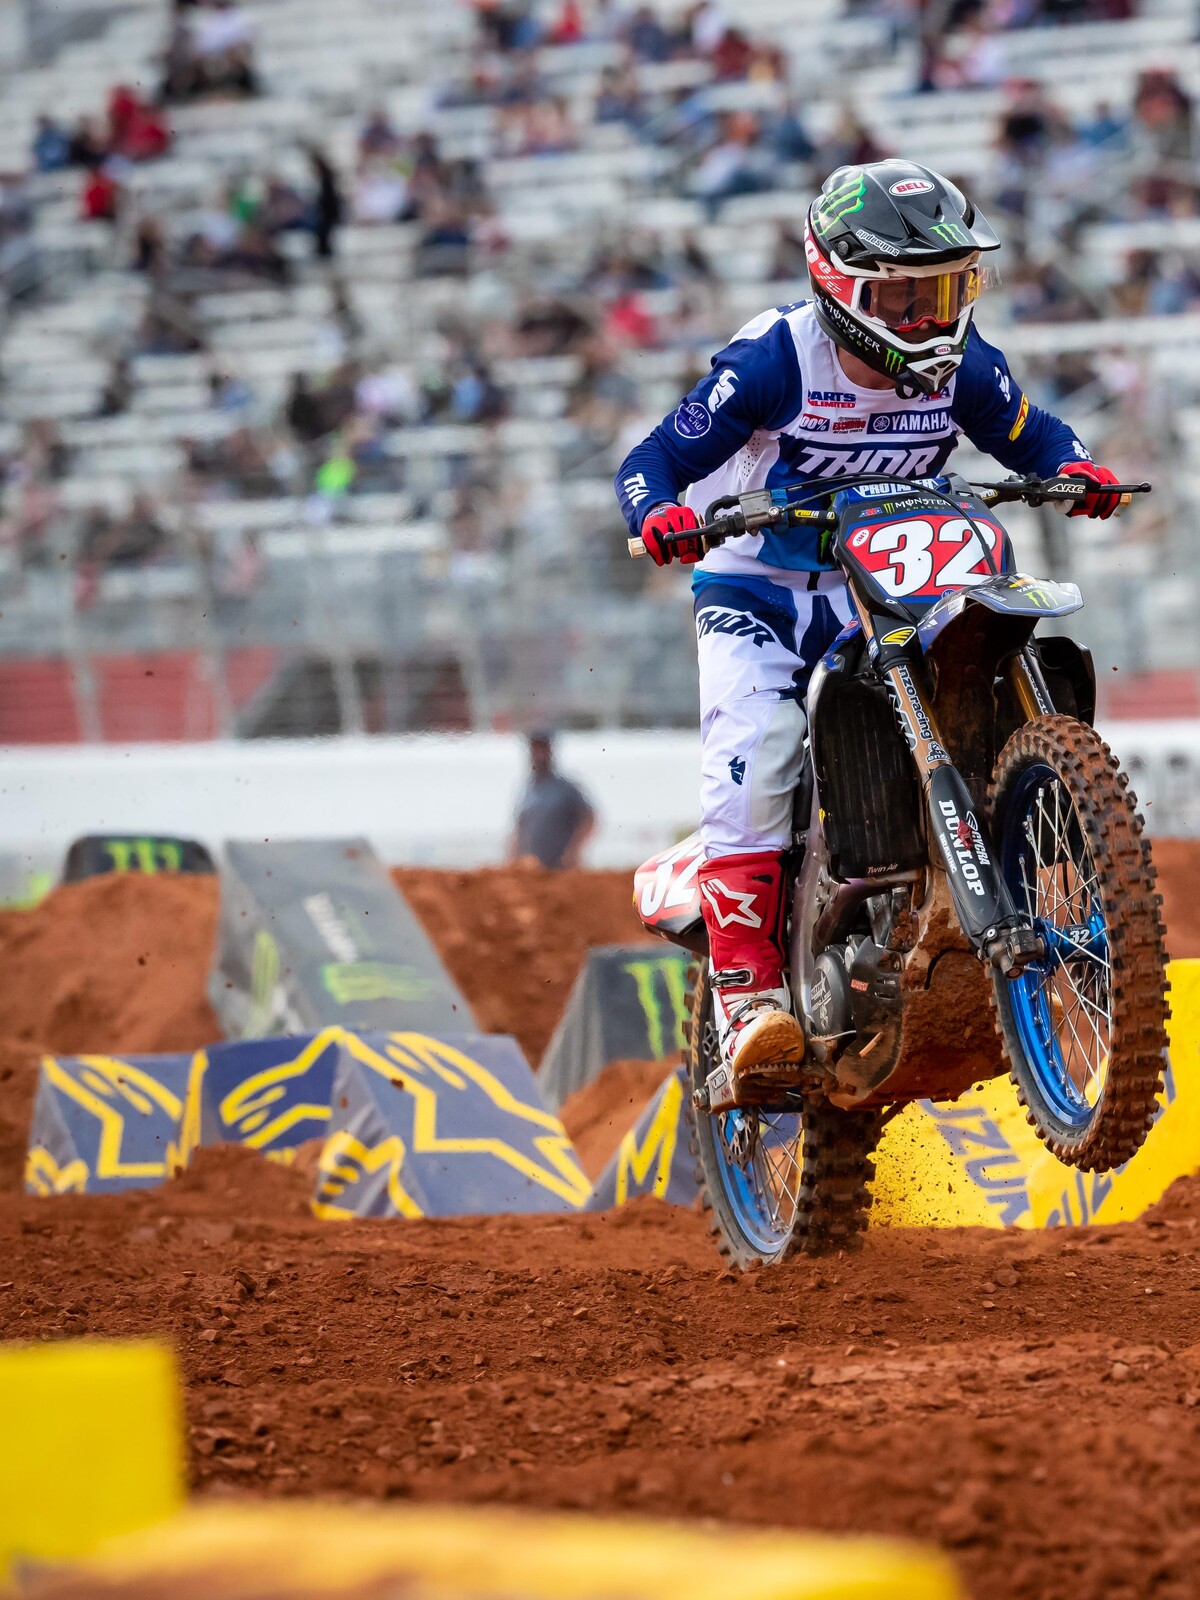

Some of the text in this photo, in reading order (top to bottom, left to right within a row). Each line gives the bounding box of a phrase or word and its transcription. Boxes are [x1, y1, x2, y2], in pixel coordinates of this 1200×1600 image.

[896, 182, 929, 193] BELL
[892, 411, 949, 431] YAMAHA
[797, 446, 940, 478] THOR
[1047, 483, 1086, 493] ARC
[869, 520, 997, 597] 32
[698, 610, 777, 649] THOR
[972, 830, 991, 866] CYCRA
[1070, 929, 1091, 944] 32
